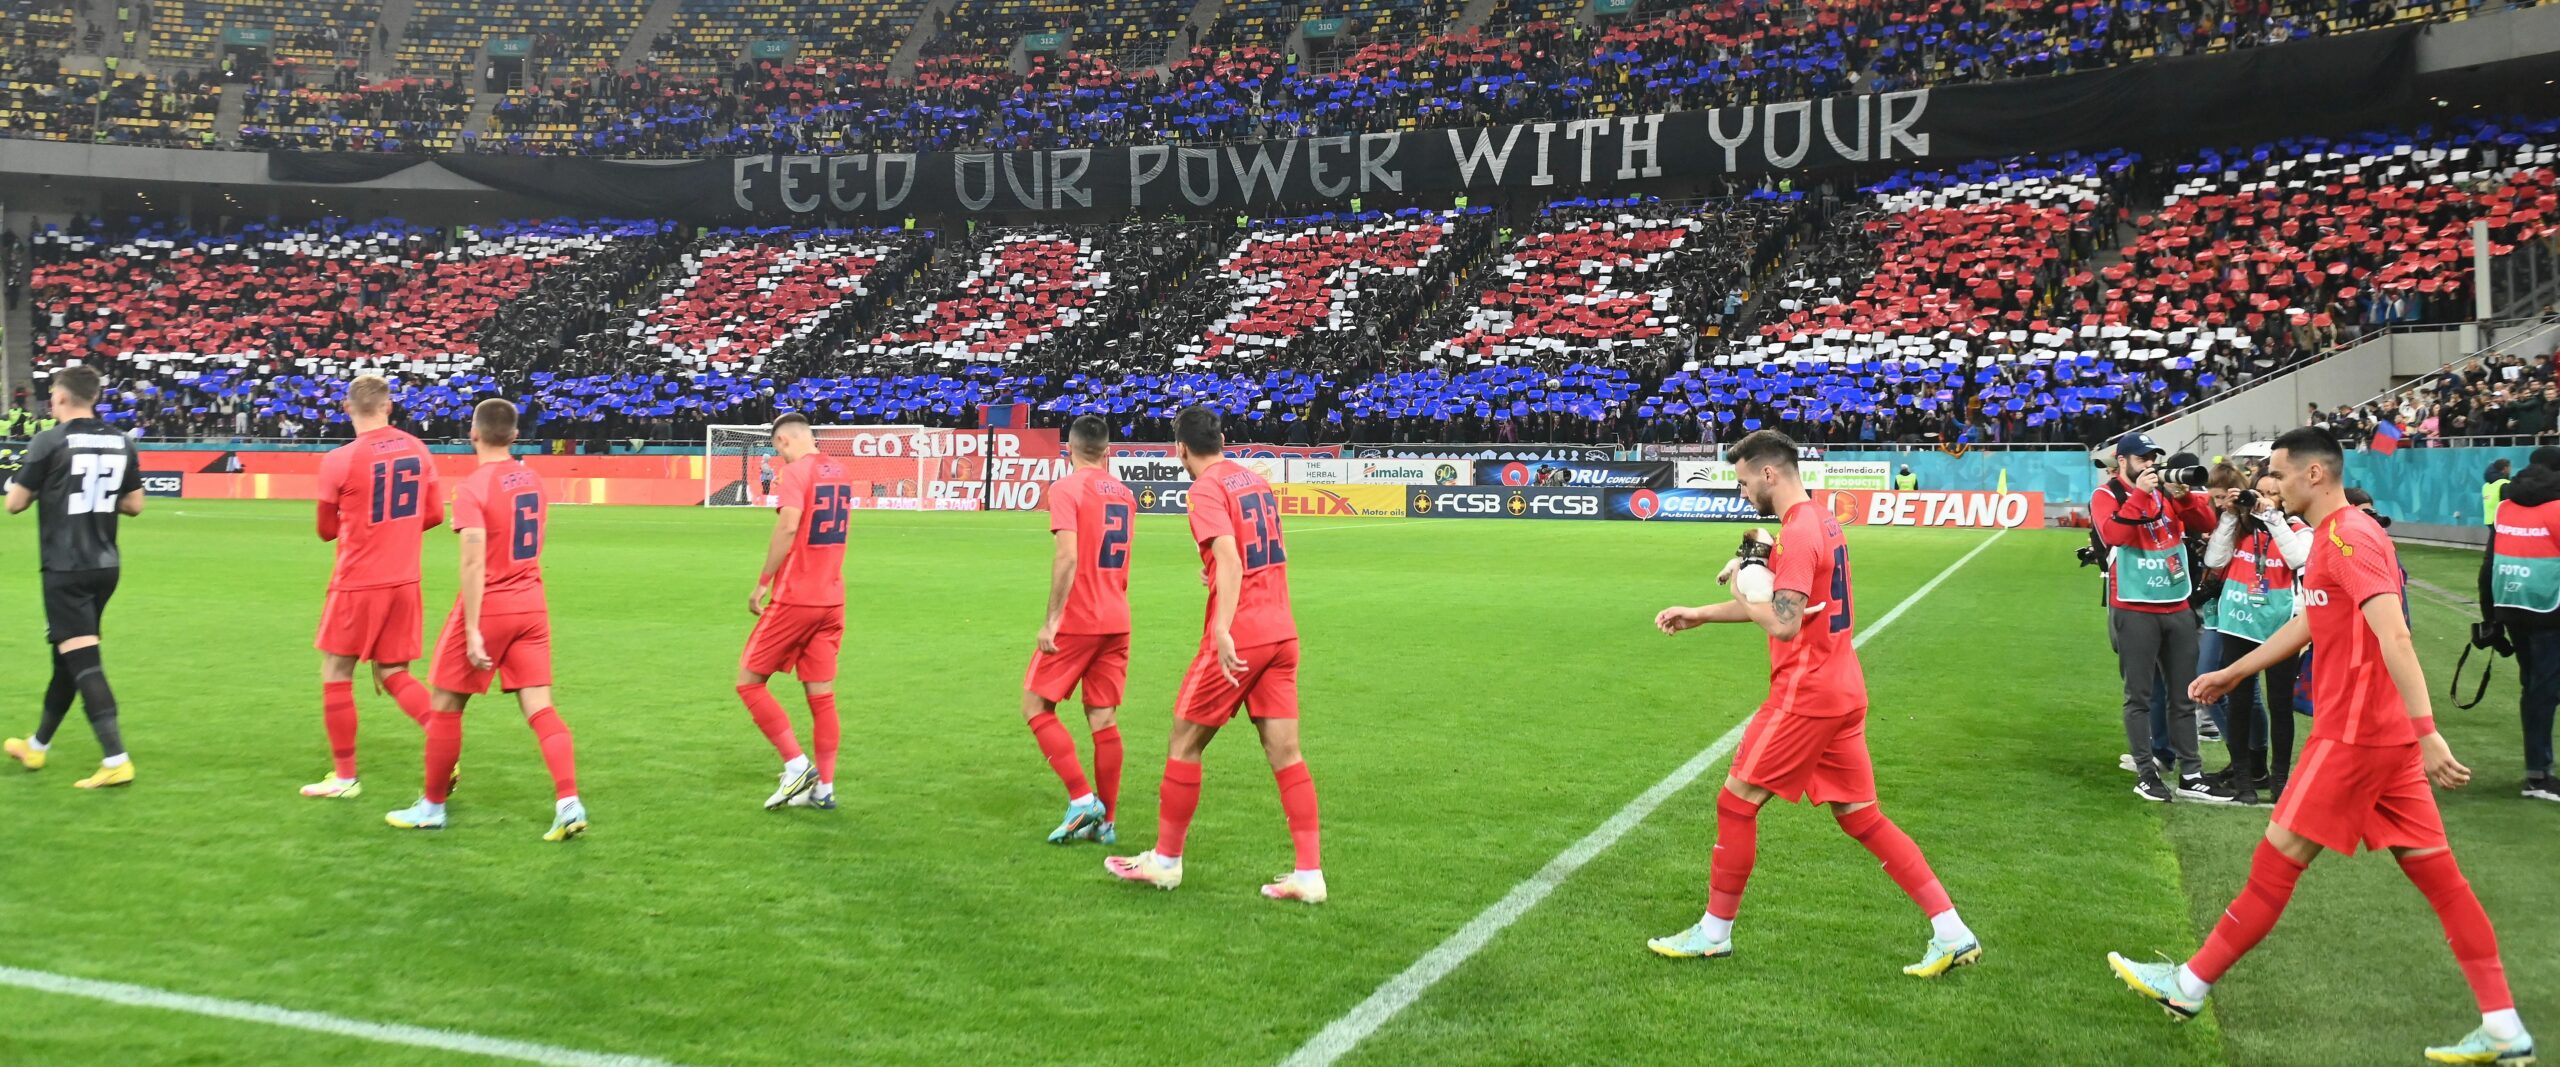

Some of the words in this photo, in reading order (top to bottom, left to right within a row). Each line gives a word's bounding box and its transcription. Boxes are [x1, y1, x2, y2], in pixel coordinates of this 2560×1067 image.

[1318, 23, 1333, 31] 310
[767, 44, 781, 52] 314
[1040, 37, 1054, 45] 312
[733, 153, 917, 212] FEED
[954, 148, 1091, 211] OUR
[1129, 131, 1404, 208] POWER
[1447, 112, 1664, 188] WITH
[1707, 88, 1930, 173] YOUR
[852, 432, 902, 457] GO
[909, 432, 1020, 458] SUPER
[1796, 447, 1820, 459] TA
[980, 458, 1075, 481] BETAN
[1118, 461, 1184, 482] walter
[1362, 462, 1424, 479] Himalaya
[1567, 469, 1609, 484] DRU
[1802, 470, 1818, 482] IA
[1825, 465, 1886, 474] idealmedia.ro
[68, 453, 128, 515] 32
[371, 456, 421, 524] 16
[1271, 487, 1288, 496] ell
[926, 480, 1041, 510] BETANO
[1158, 489, 1188, 507] FC
[1434, 493, 1501, 514] FCSB
[934, 498, 979, 511] BETANO
[1361, 508, 1388, 516] Motor
[1390, 508, 1405, 516] oils
[1530, 494, 1599, 515] FCSB
[1663, 496, 1746, 512] CEDRU
[1867, 493, 2029, 527] BETANO
[808, 484, 851, 545] 26
[512, 492, 539, 560] 6
[1238, 492, 1286, 569] 33
[2495, 523, 2551, 537] SUPERLIGA
[1099, 503, 1129, 569] 2
[2137, 557, 2166, 570] FOT
[2498, 563, 2531, 578] FOTO
[1829, 544, 1852, 633] 9
[2146, 575, 2171, 588] 424
[2228, 607, 2255, 624] 404
